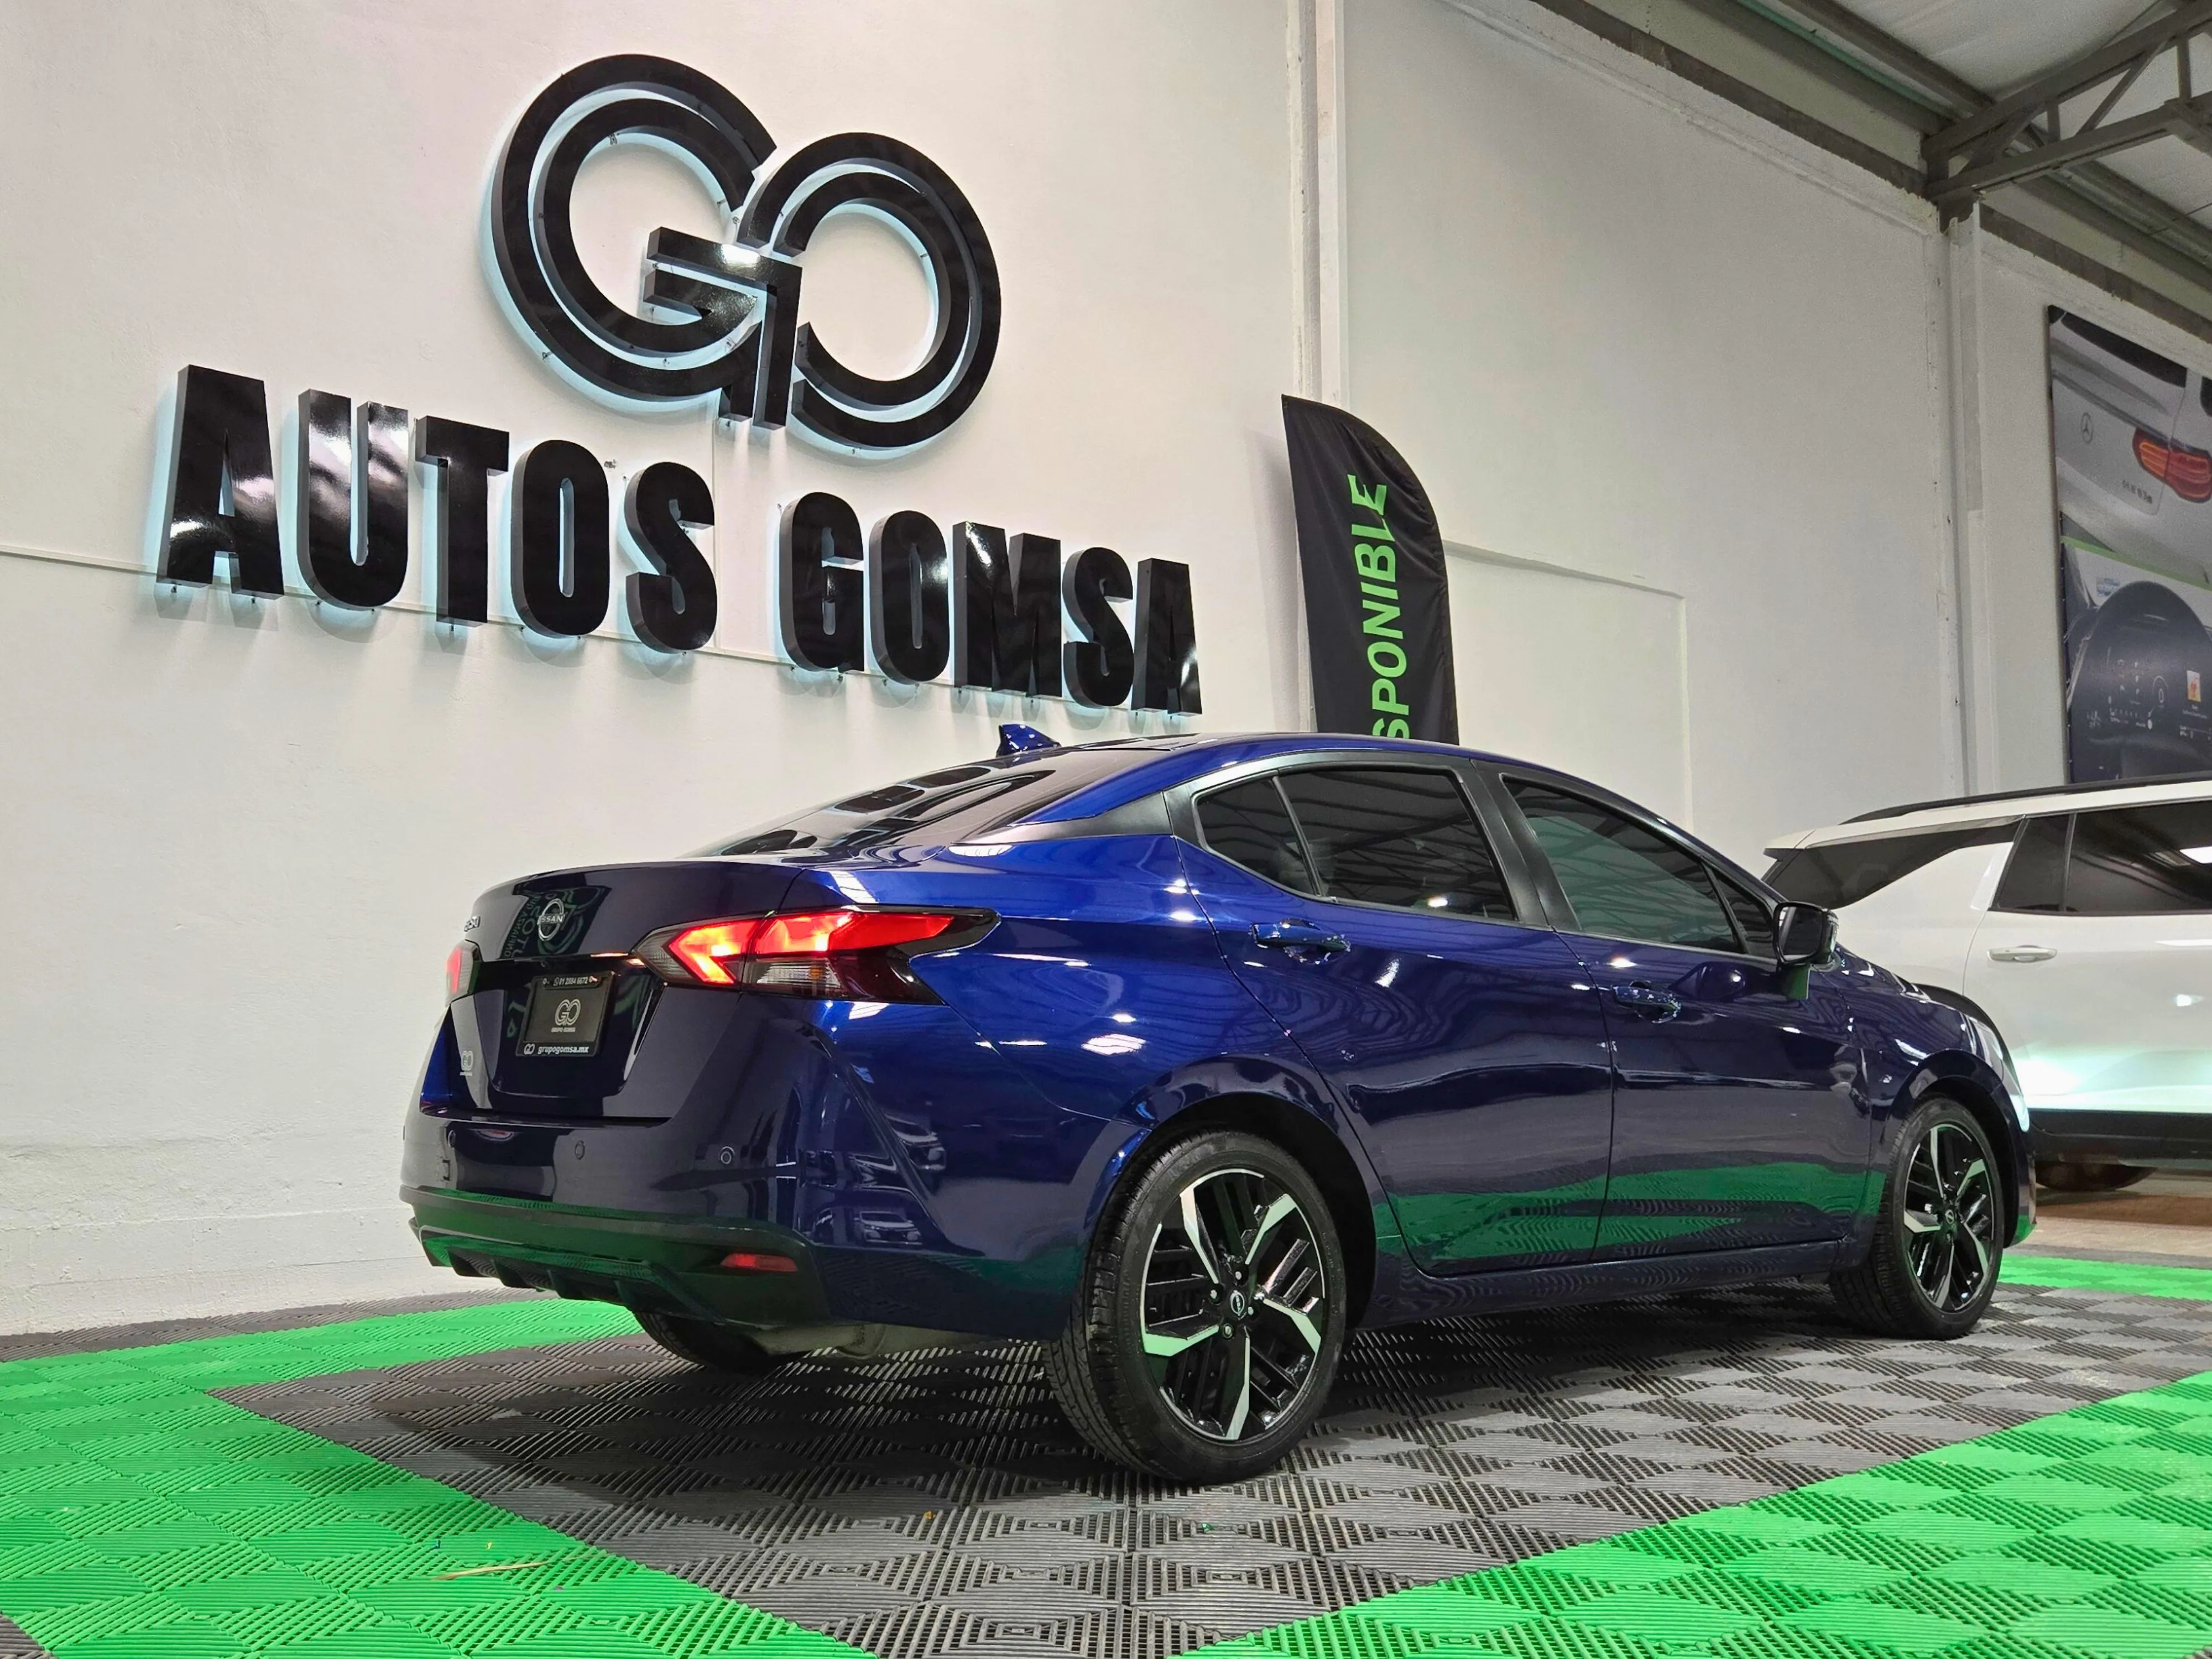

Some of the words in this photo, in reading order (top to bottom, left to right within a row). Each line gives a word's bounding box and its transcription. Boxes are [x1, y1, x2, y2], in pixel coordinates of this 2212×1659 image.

[156, 364, 718, 654] AUTOS
[779, 491, 1202, 716] GOMSA
[538, 914, 564, 923] SSAN
[538, 1046, 589, 1055] grupogomsa.mx
